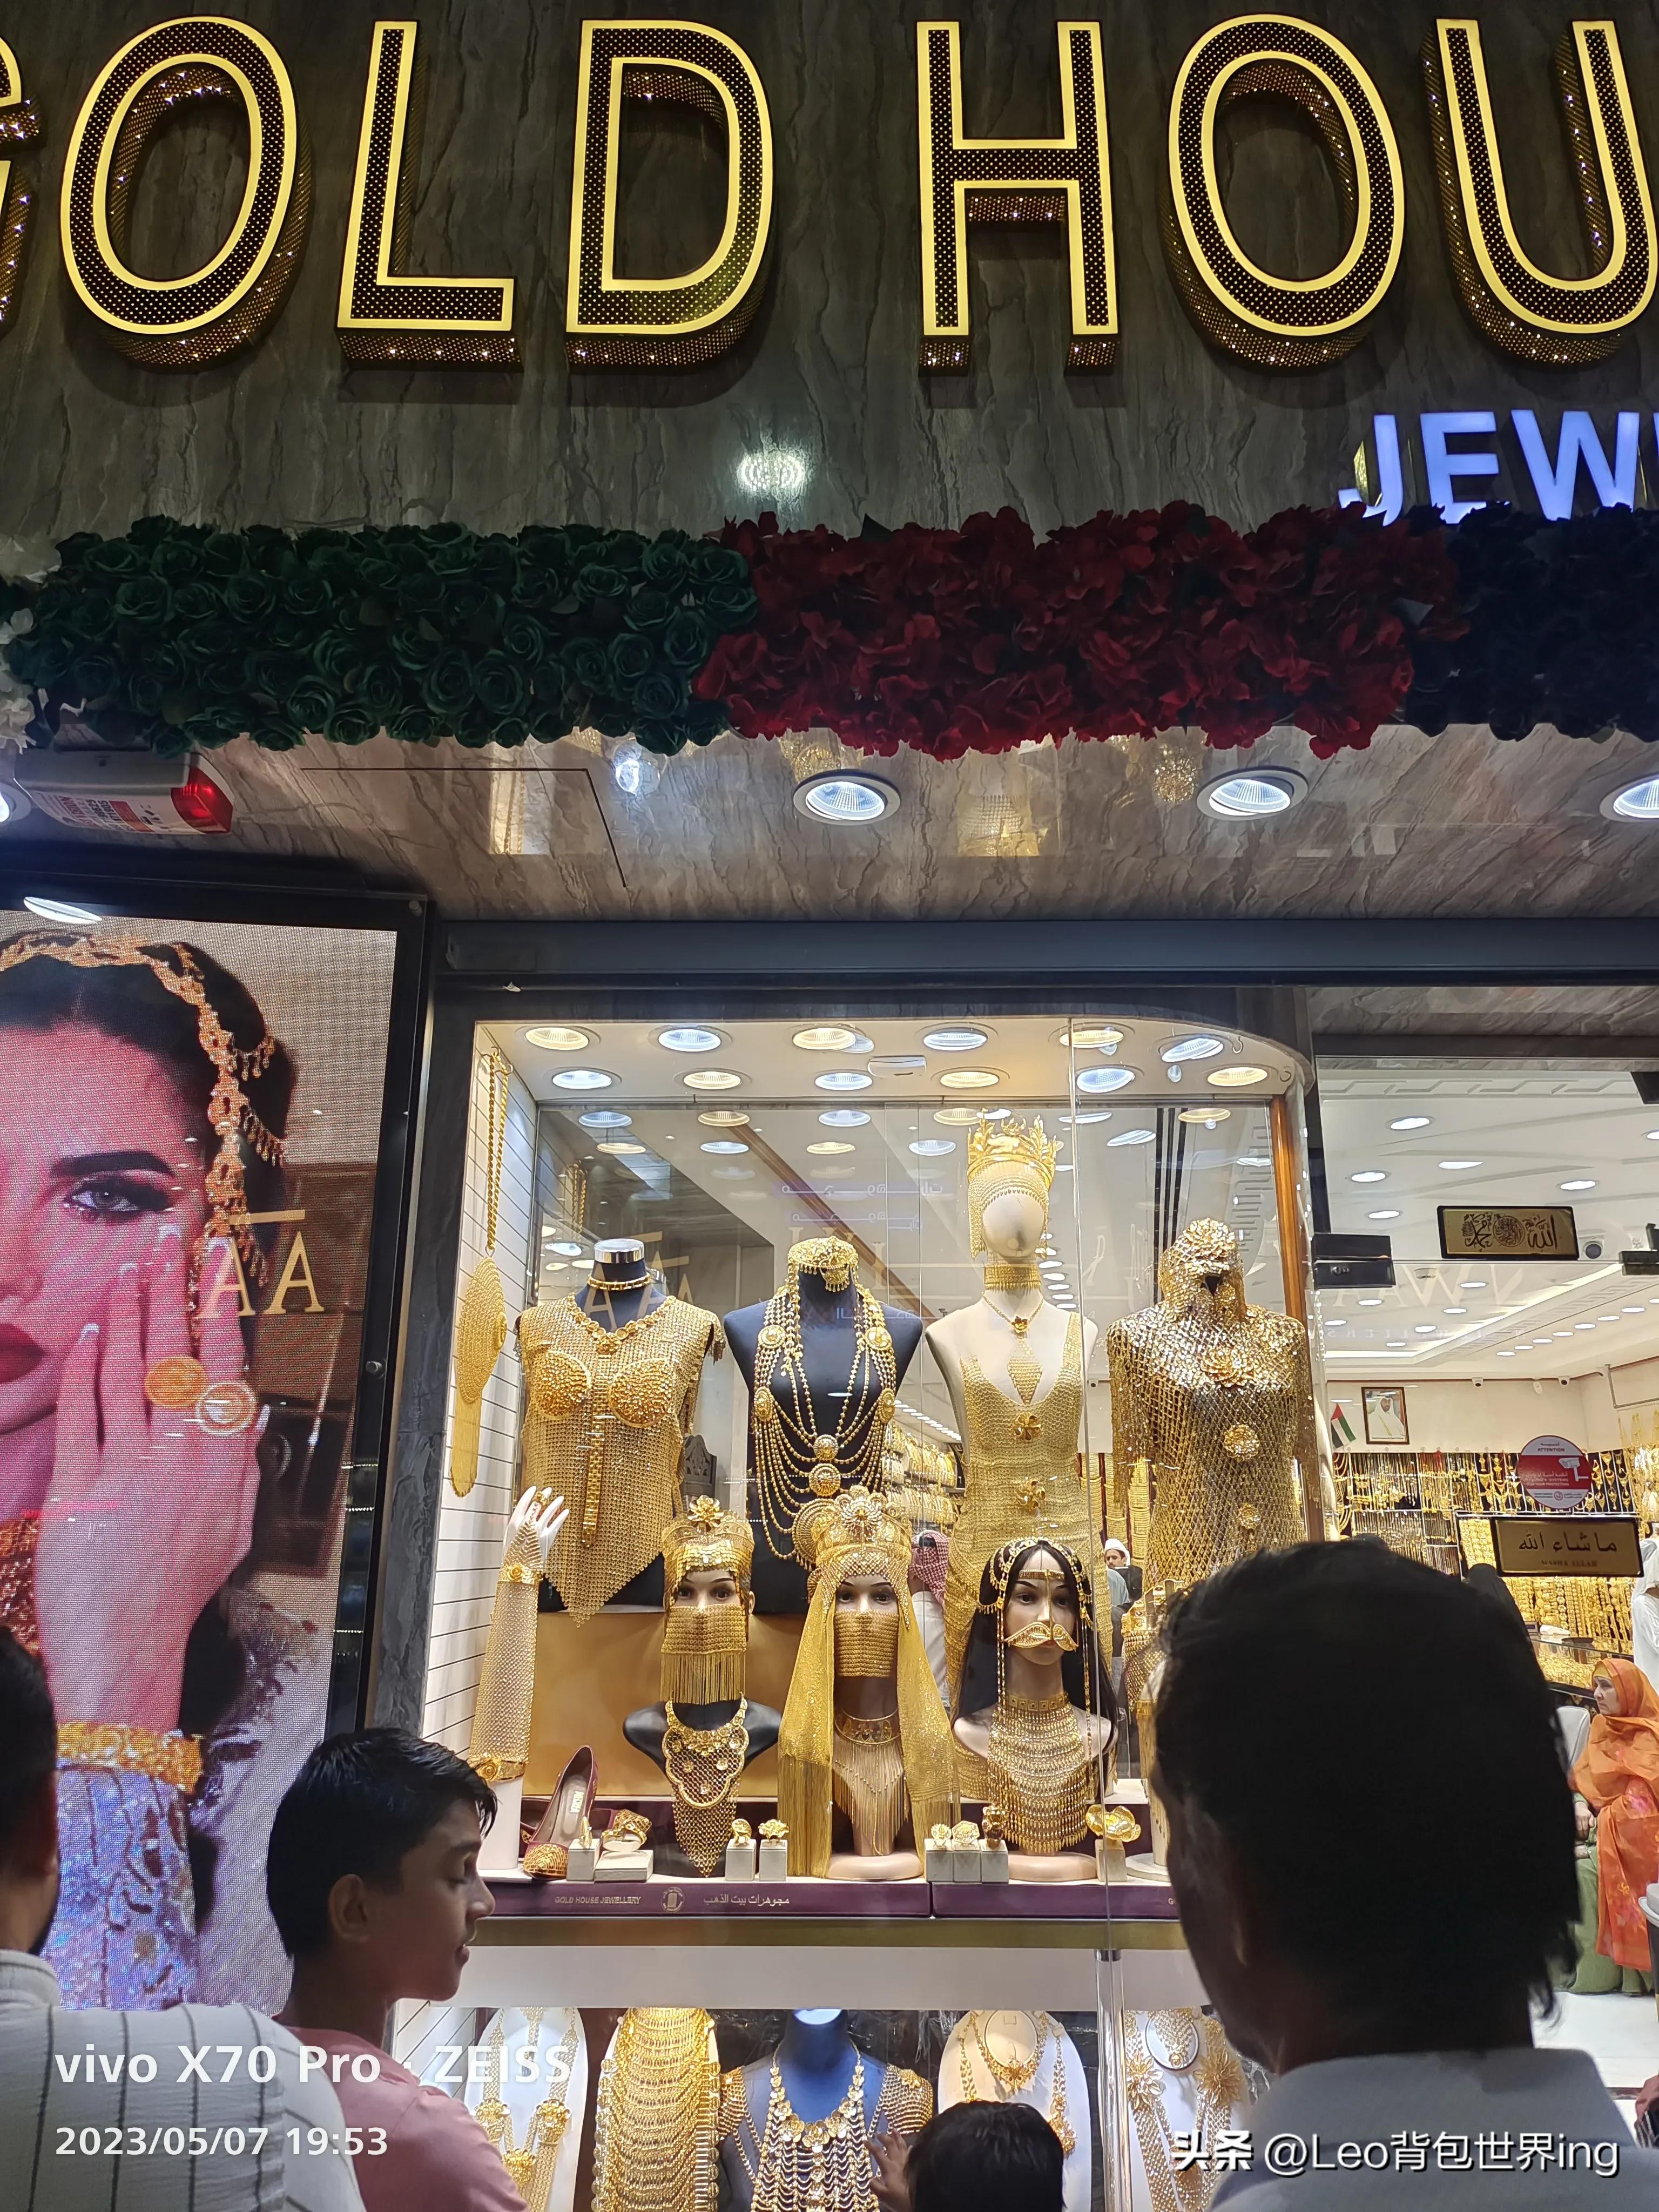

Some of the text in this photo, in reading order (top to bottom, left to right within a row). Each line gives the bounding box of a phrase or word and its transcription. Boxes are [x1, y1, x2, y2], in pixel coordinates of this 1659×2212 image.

[0, 15, 773, 335] OLD
[1338, 409, 1659, 526] JEW
[600, 1896, 642, 1904] JEWELLERY
[730, 1895, 746, 1906] بيت
[748, 1894, 790, 1906] مجوهرات
